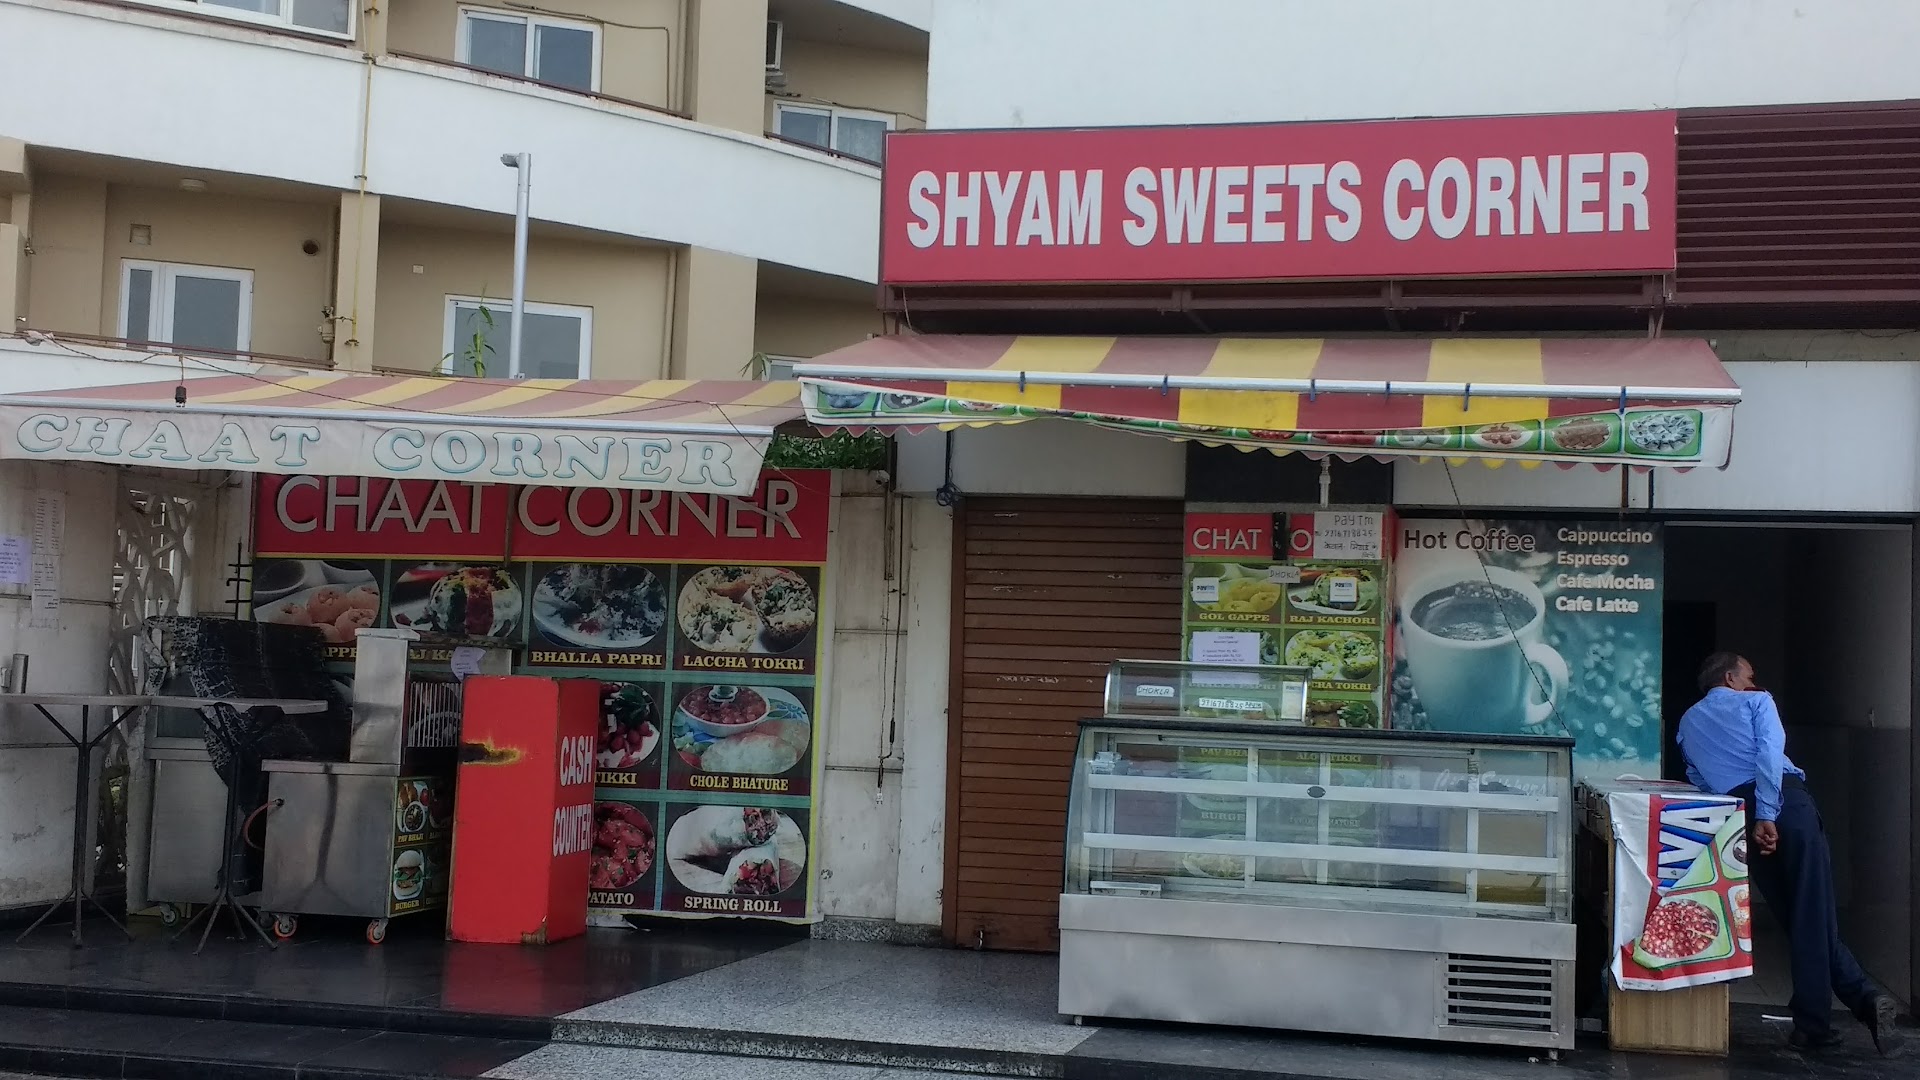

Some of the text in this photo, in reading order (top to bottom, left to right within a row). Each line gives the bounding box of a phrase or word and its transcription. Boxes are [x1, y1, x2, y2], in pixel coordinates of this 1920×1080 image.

[906, 152, 1650, 248] SHYAM SWEETS CORNER
[17, 414, 737, 486] CHAAT CORNER
[276, 475, 802, 539] CHAAT CORNER
[1192, 528, 1262, 550] CHAT
[1404, 528, 1536, 551] Hot Coffee
[1557, 527, 1653, 544] Cappuccino
[1557, 550, 1629, 567] Espresso
[1556, 574, 1655, 590] Cafe Mocha
[1555, 596, 1639, 613] Cafe Latte
[1199, 613, 1270, 622] GOL GAPPE
[1289, 615, 1376, 625] RAJ KACHORI
[532, 651, 662, 666] BHALLA PAPRI
[683, 655, 804, 670] LACCHA TOKRI
[560, 735, 593, 786] CASH
[689, 774, 789, 791] CHOLE BHATURE
[552, 803, 592, 858] COUNTER
[395, 900, 419, 910] BURGER
[684, 895, 782, 913] SPRING ROLL
